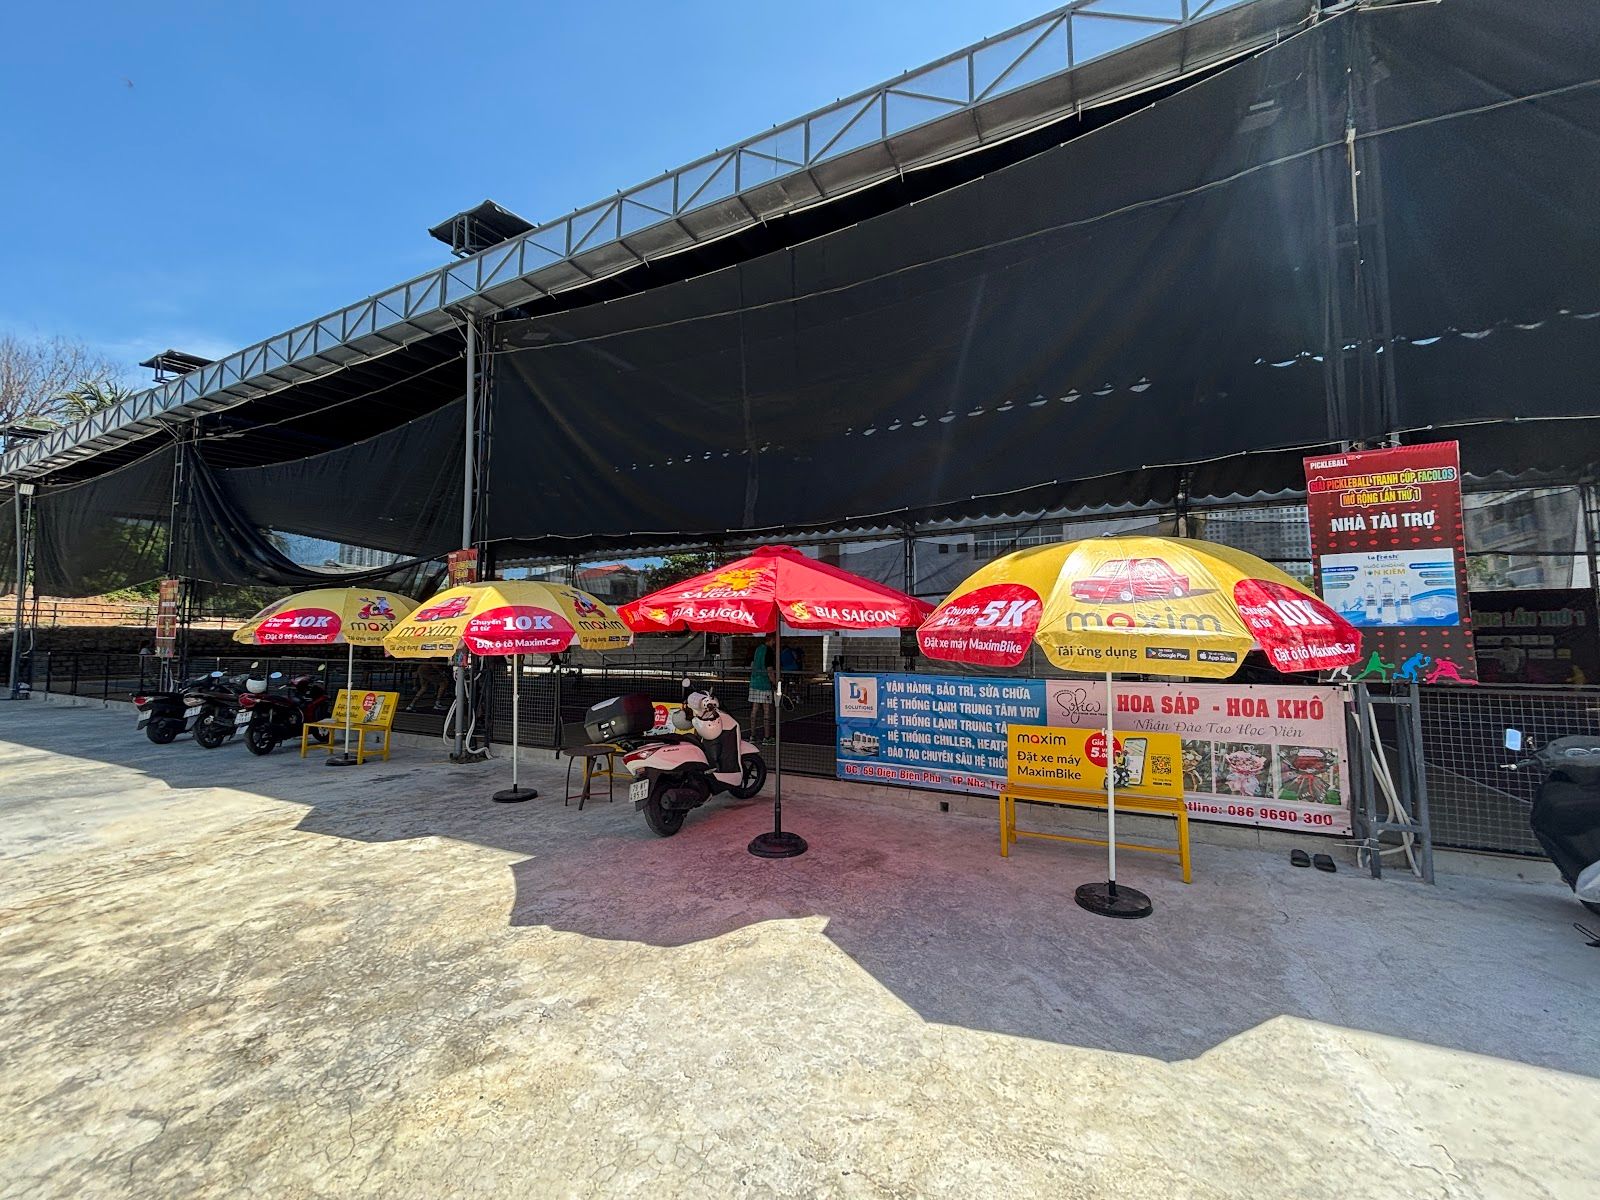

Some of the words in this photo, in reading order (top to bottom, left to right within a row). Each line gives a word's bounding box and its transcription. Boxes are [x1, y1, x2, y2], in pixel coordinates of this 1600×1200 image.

[1310, 458, 1348, 470] PICKLEBALL
[1326, 475, 1371, 490] PICKLEBALL
[1372, 472, 1398, 486] TRANH
[1399, 469, 1416, 483] CÚP
[1417, 468, 1455, 482] FACOLOS
[1413, 488, 1419, 500] 1
[1331, 514, 1366, 532] NHÀ
[1370, 511, 1398, 529] TÀI
[1401, 510, 1436, 529] TRỢ
[289, 616, 333, 627] 10K
[671, 607, 694, 619] BIA
[697, 607, 755, 624] SAIGON
[814, 605, 840, 619] BIA
[841, 608, 897, 622] SAIGON
[944, 604, 980, 616] Chuyến
[974, 600, 1039, 627] 5K
[1065, 607, 1223, 633] maxim
[1266, 600, 1333, 626] 10K
[351, 620, 394, 631] maxi
[397, 622, 458, 638] maxim
[470, 618, 501, 626] Chuyến
[503, 616, 553, 630] 10K
[578, 618, 626, 631] maxim
[515, 638, 560, 647] MaximCar
[923, 637, 938, 650] Đặt
[939, 639, 949, 648] xe
[950, 637, 968, 651] máy
[969, 638, 1023, 654] MaximBike
[1308, 643, 1356, 658] MaximCar
[1056, 645, 1074, 658] Tải
[1076, 645, 1102, 659] ứng
[1105, 645, 1137, 659] dụng
[886, 680, 904, 694] VẬN
[906, 680, 934, 696] HÀNH,
[936, 682, 955, 697] BẢO
[957, 684, 976, 698] TRÌ,
[979, 683, 1000, 698] SỬA
[1002, 685, 1031, 700] CHỮA
[887, 698, 898, 710] HỆ
[900, 698, 930, 711] THỐNG
[932, 702, 957, 715] LẠNH
[959, 703, 992, 715] TRUNG
[994, 703, 1017, 717] TÂM
[1020, 707, 1040, 718] VRV
[1116, 694, 1155, 713] HOA
[1226, 698, 1270, 718] HOA
[1277, 695, 1324, 720] KHÔ
[887, 714, 899, 727] HỆ
[901, 714, 930, 728] THỐNG
[933, 718, 958, 731] LẠNH
[960, 721, 992, 733] TRUNG
[994, 721, 1008, 734] TÂ
[1133, 718, 1170, 732] Nhận
[1236, 723, 1265, 737] Học
[1270, 725, 1304, 738] Viên
[887, 730, 899, 743] HỆ
[901, 730, 932, 745] THỐNG
[934, 736, 975, 750] CHILLER,
[1017, 732, 1066, 746] maxim
[887, 746, 903, 759] ĐÀO
[905, 748, 920, 762] TẠO
[922, 748, 953, 763] CHUYÊN
[956, 750, 972, 766] SÂU
[975, 756, 986, 769] HỆ
[1017, 750, 1038, 763] Đặt
[1040, 754, 1054, 763] xe
[1057, 752, 1081, 767] máy
[1017, 766, 1082, 780] MaximBike
[967, 777, 986, 788] Nha
[990, 780, 1006, 791] Tra
[1184, 801, 1222, 814] tline:
[1228, 805, 1254, 818] 086
[1260, 808, 1298, 822] 9690
[1303, 813, 1333, 826] 300
